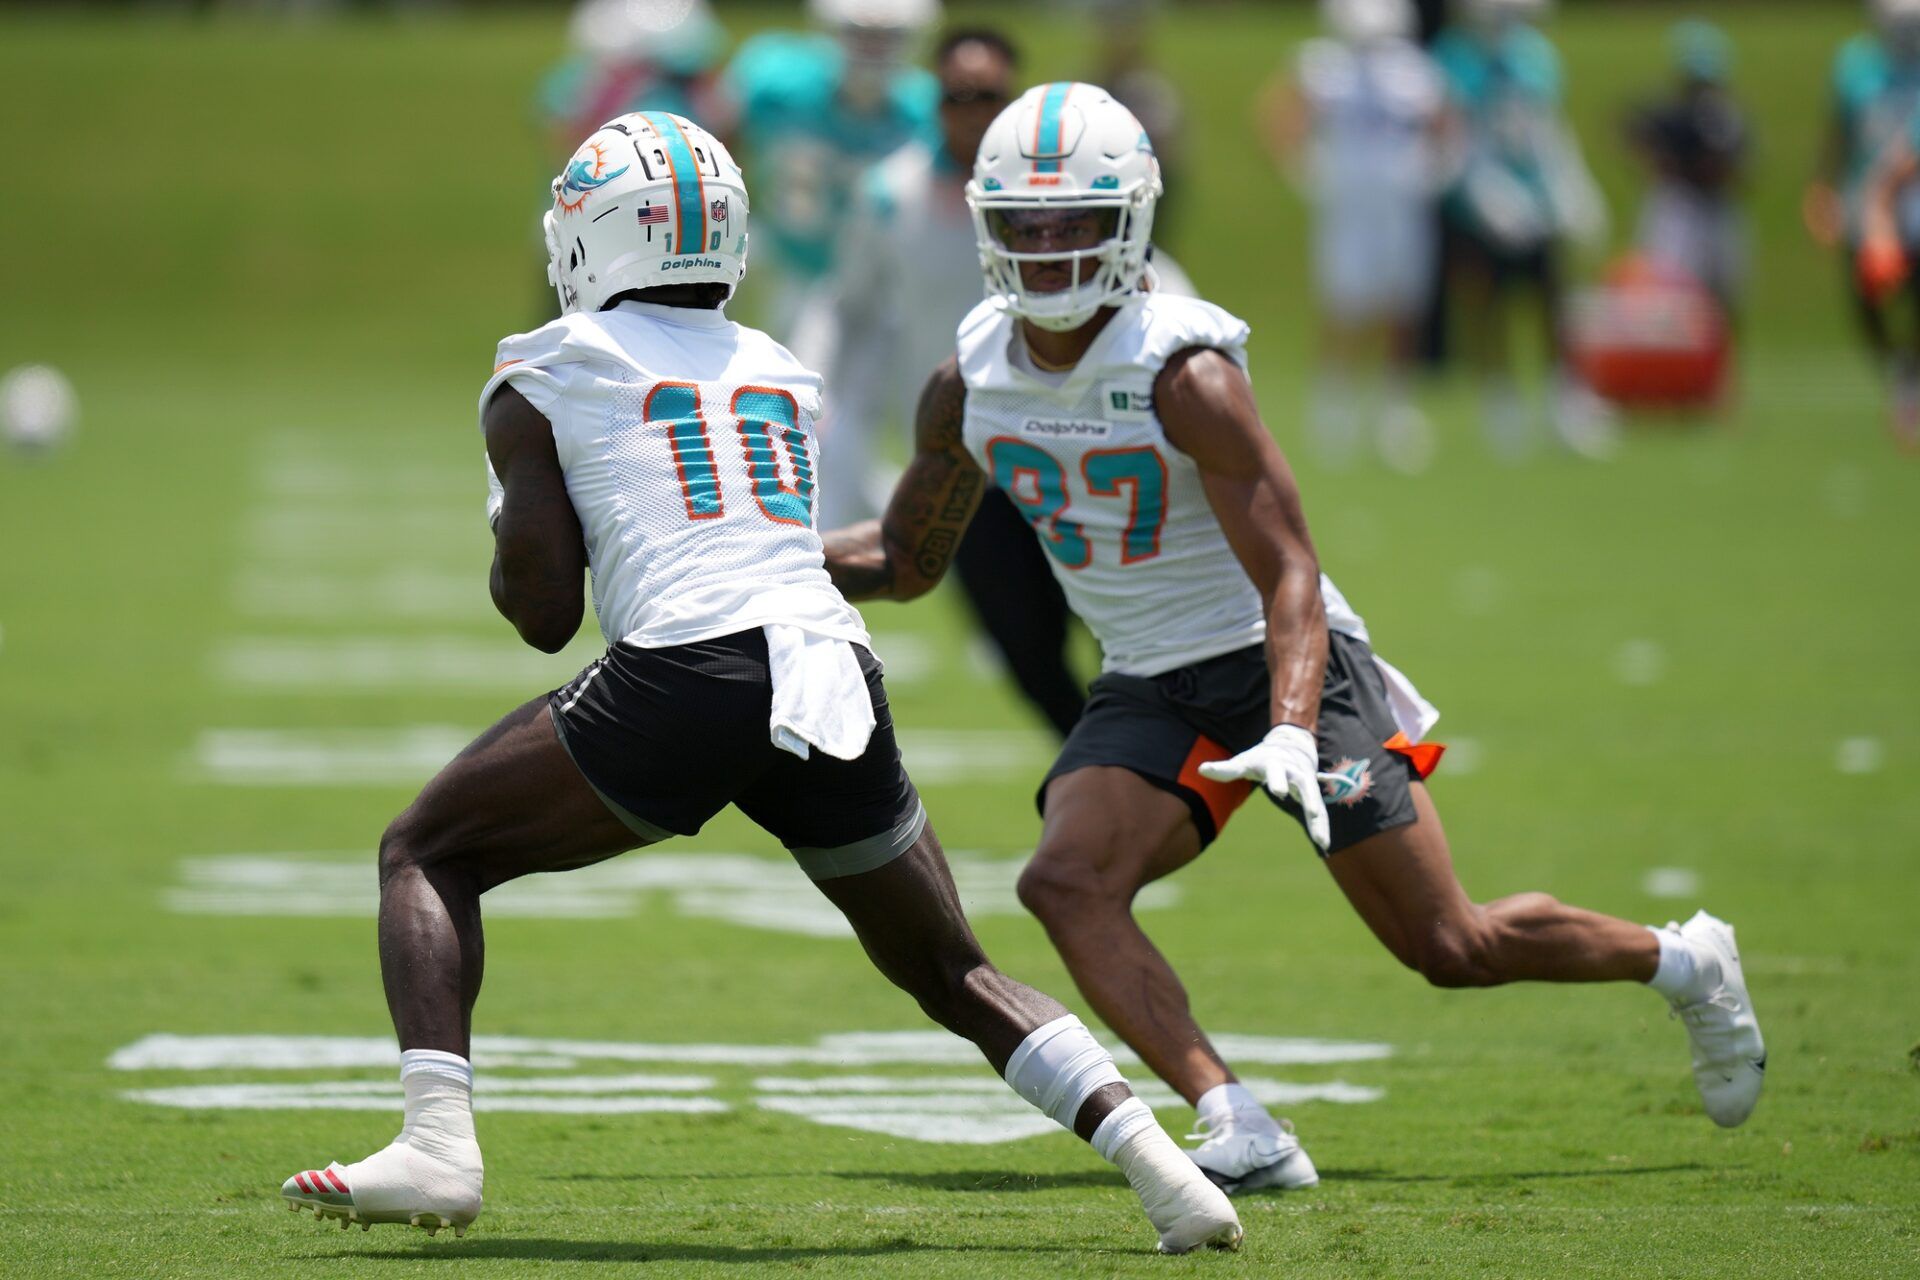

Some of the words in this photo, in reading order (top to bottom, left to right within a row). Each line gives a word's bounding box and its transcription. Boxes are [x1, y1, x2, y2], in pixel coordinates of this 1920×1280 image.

[660, 257, 722, 272] Dolphins
[643, 380, 815, 529] 10
[1025, 419, 1107, 436] Dolphins
[985, 434, 1169, 570] 87
